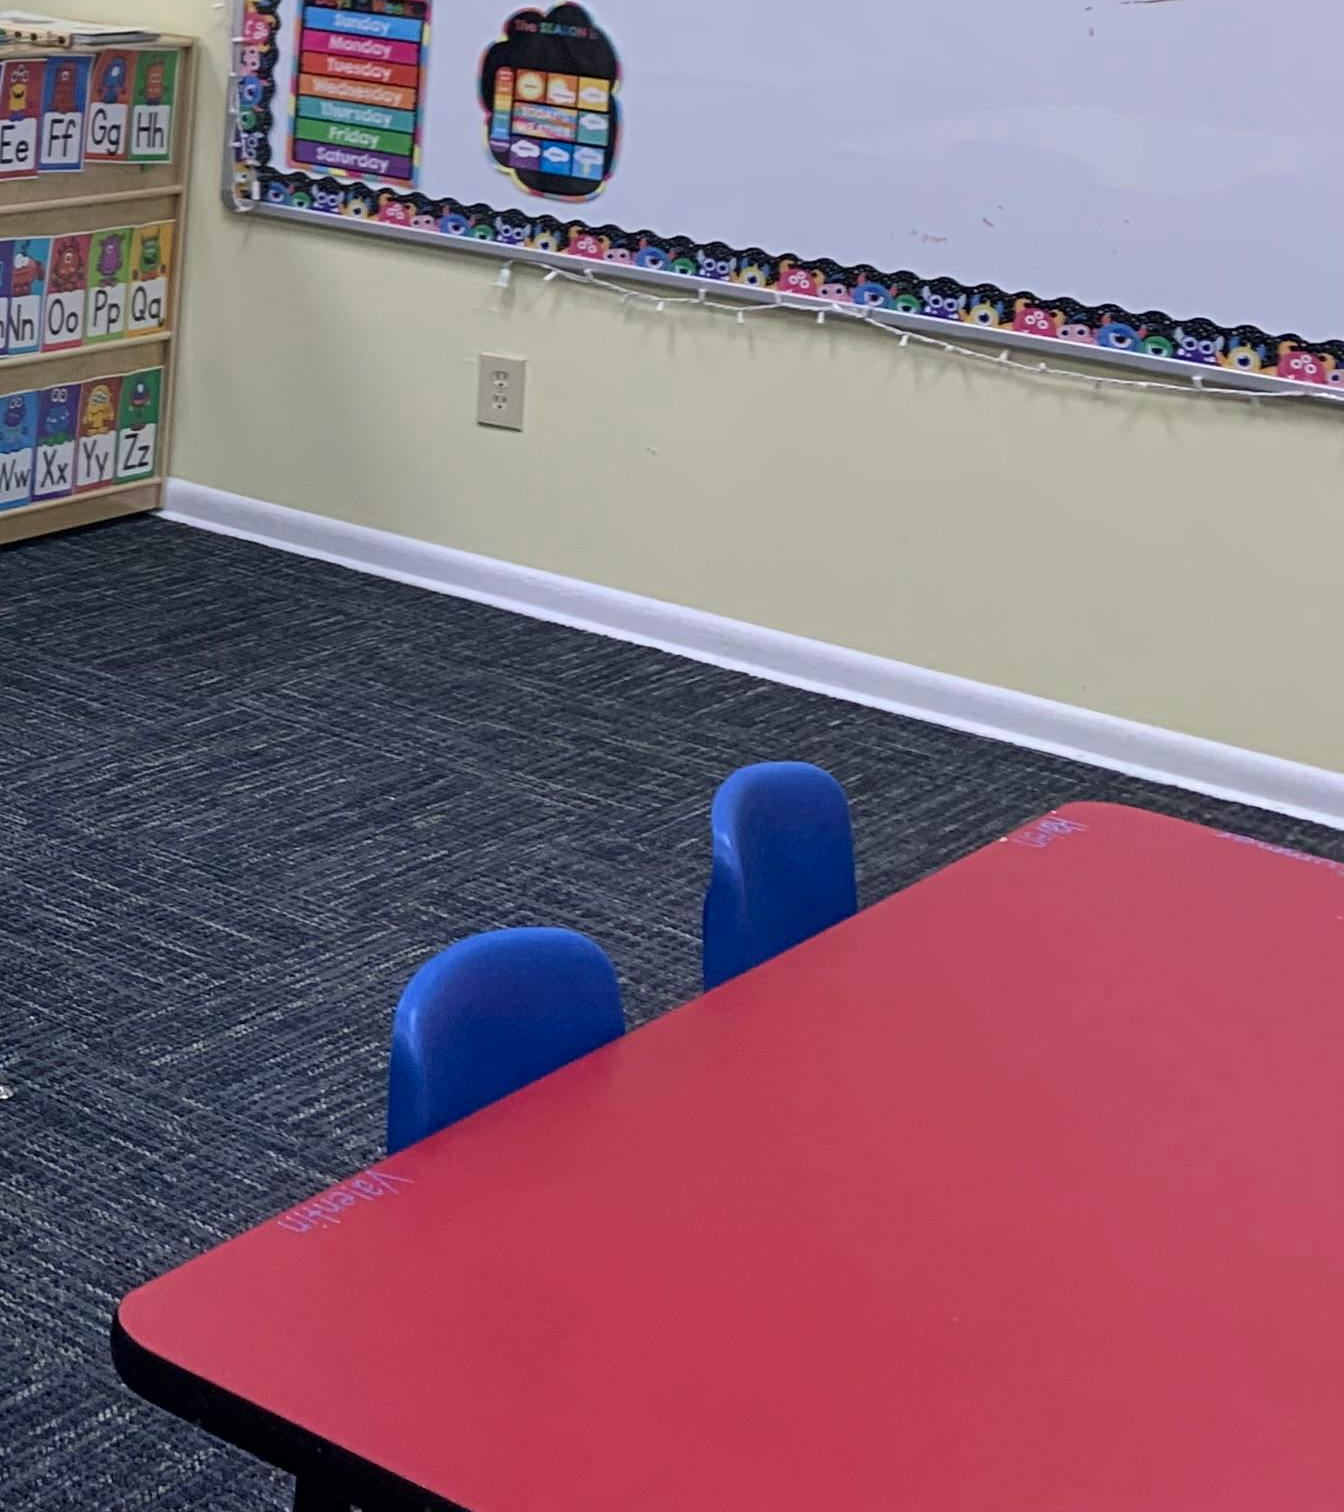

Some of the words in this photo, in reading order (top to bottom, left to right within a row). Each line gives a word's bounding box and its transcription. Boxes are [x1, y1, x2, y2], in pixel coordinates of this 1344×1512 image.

[333, 13, 392, 37] Sunday
[328, 34, 392, 59] Monday
[326, 57, 392, 82] Tuesday
[314, 78, 402, 107] Wednesday
[91, 108, 122, 155] Gg
[136, 112, 165, 148] Hh
[320, 101, 392, 128] Thursday
[0, 124, 29, 164] Ee
[47, 118, 77, 158] Ff
[329, 126, 380, 149] Friday
[316, 146, 390, 174] Saturday
[8, 304, 34, 341] Nn
[48, 298, 79, 336] Oo
[93, 289, 121, 334] Pp
[41, 449, 69, 487] Xx
[83, 440, 110, 481] Yy
[123, 434, 150, 471] Zz
[276, 1169, 415, 1233] Valentin
